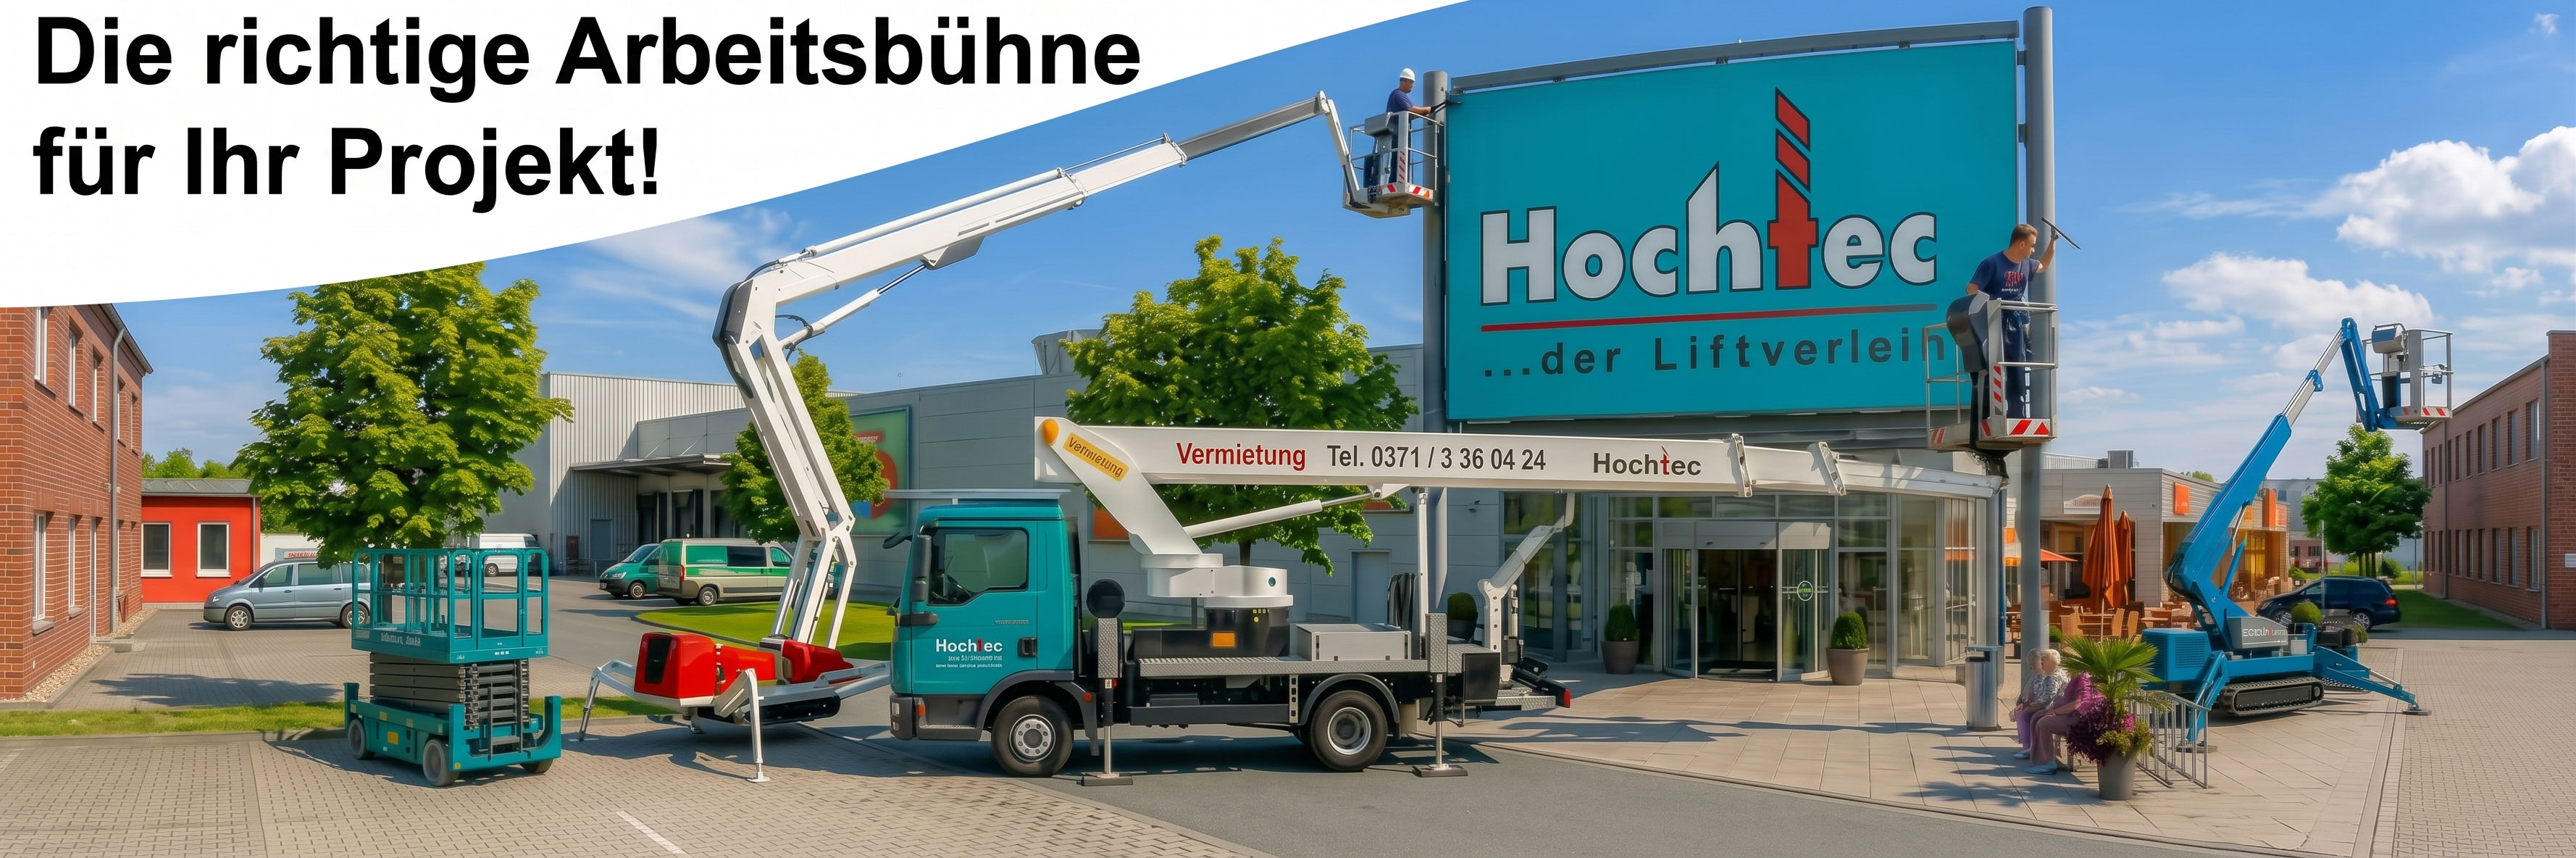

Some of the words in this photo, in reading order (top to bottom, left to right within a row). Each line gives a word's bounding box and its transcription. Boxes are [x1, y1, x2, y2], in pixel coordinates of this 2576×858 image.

[1480, 87, 1937, 307] Hochtec
[1484, 342, 1621, 377] ...der
[1069, 436, 1124, 478] Vermietung
[1176, 443, 1305, 471] Vermietung
[1327, 445, 1364, 467] Tel.
[1371, 446, 1418, 468] 0371
[1427, 446, 1435, 468] /
[1440, 447, 1452, 469] 3
[1459, 447, 1484, 470] 36
[1490, 448, 1515, 470] 04
[1521, 449, 1547, 470] 24
[1593, 446, 1702, 476] Hochtec
